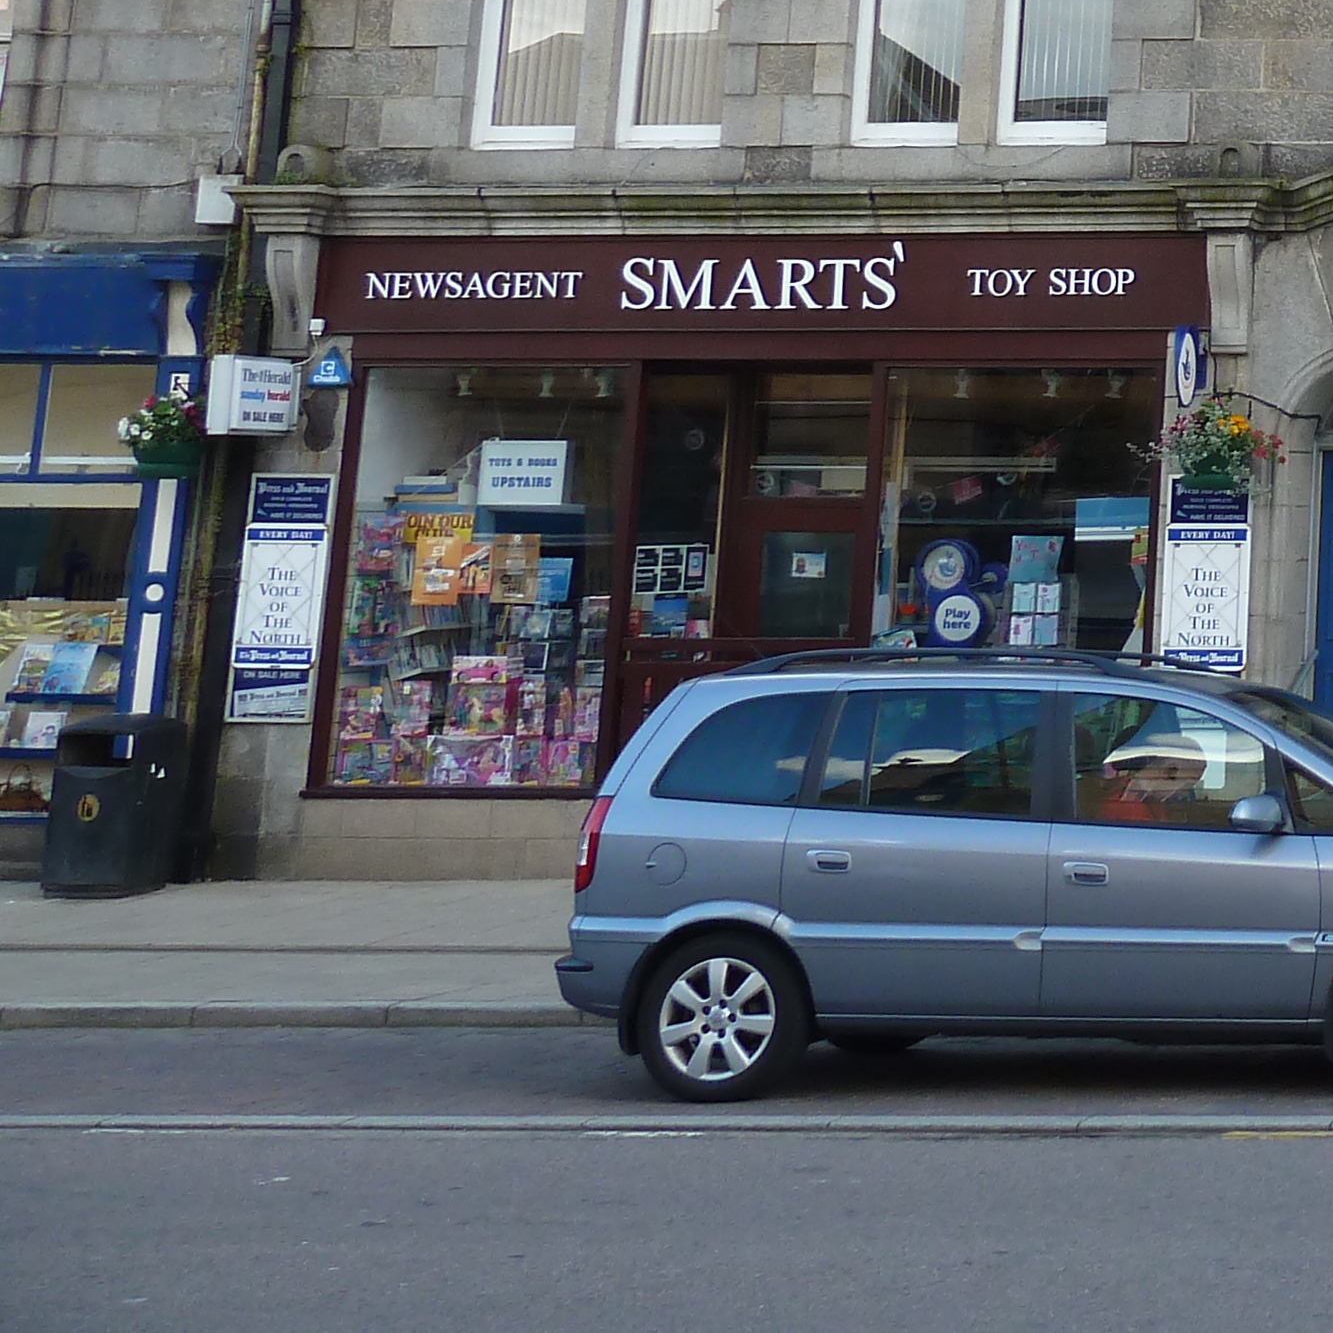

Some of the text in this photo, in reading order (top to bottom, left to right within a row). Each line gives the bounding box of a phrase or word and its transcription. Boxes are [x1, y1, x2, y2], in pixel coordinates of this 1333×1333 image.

[365, 271, 584, 300] NEWSAGENT
[966, 268, 1136, 297] TOY SHOP
[242, 368, 292, 385] The Herald
[266, 389, 291, 402] herald
[252, 411, 267, 423] SALE
[268, 412, 284, 424] HERE
[488, 458, 512, 466] TOYS
[491, 476, 552, 488] UPSTAIRS
[295, 482, 328, 495] Journal
[437, 514, 474, 529] OUR
[259, 530, 313, 539] EVERY DAY!
[1180, 530, 1236, 539] EVERY DAY!
[945, 607, 971, 621] Play
[942, 620, 972, 630] here
[250, 650, 271, 661] Press
[279, 650, 309, 661] Journal
[1178, 652, 1201, 662] Press
[1208, 652, 1239, 664] Journal
[258, 671, 278, 679] SALE
[279, 671, 301, 679] HERE
